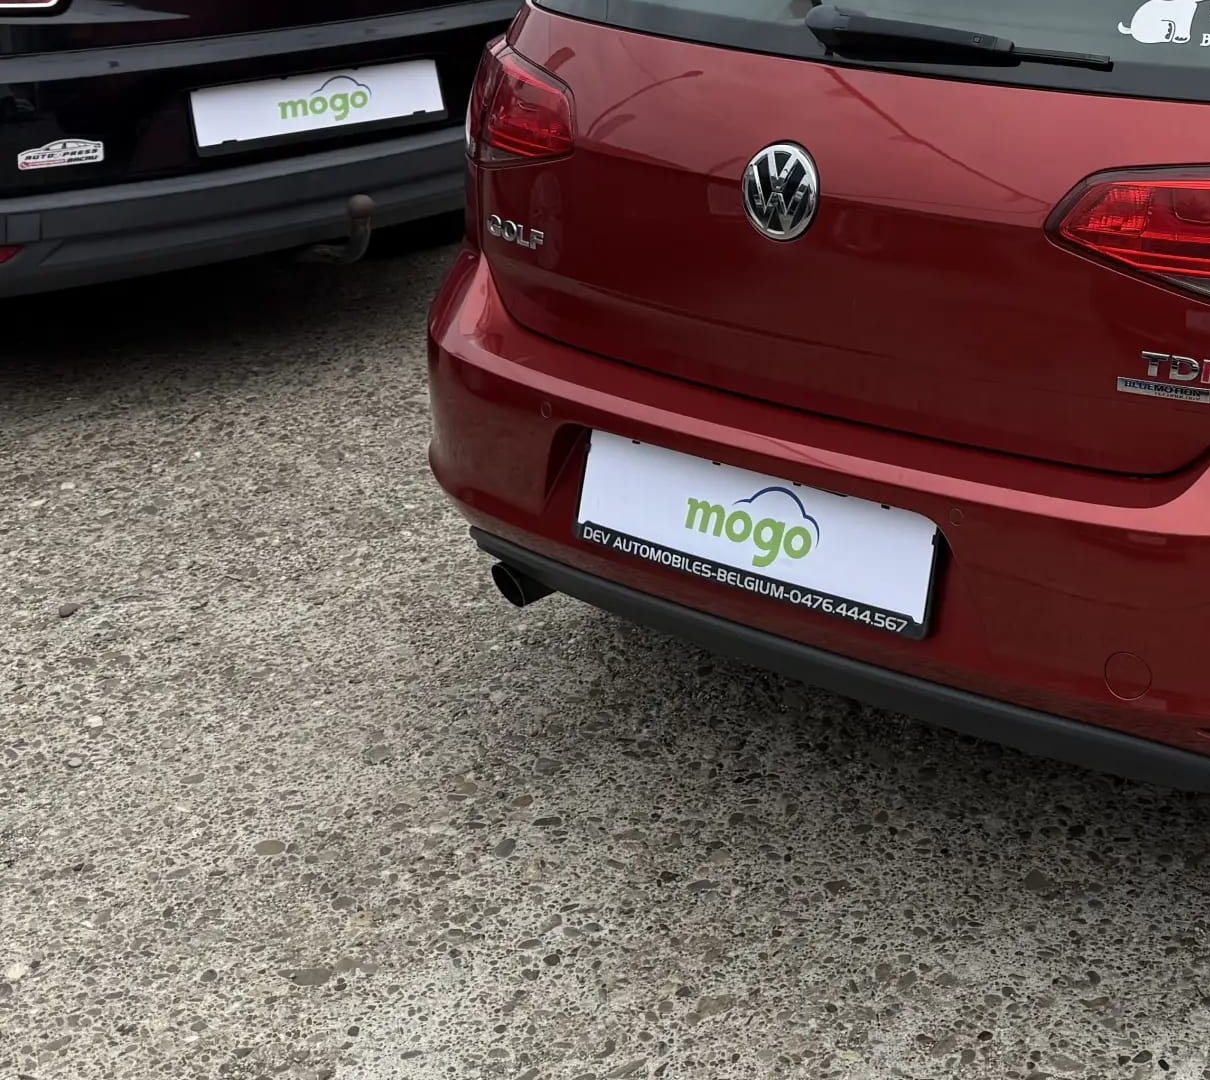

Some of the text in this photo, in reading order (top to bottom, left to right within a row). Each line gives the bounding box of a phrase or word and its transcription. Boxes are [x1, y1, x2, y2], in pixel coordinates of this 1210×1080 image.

[278, 91, 368, 121] mogo
[486, 214, 544, 250] GOLF
[583, 526, 611, 545] DEV
[685, 497, 812, 567] mogo
